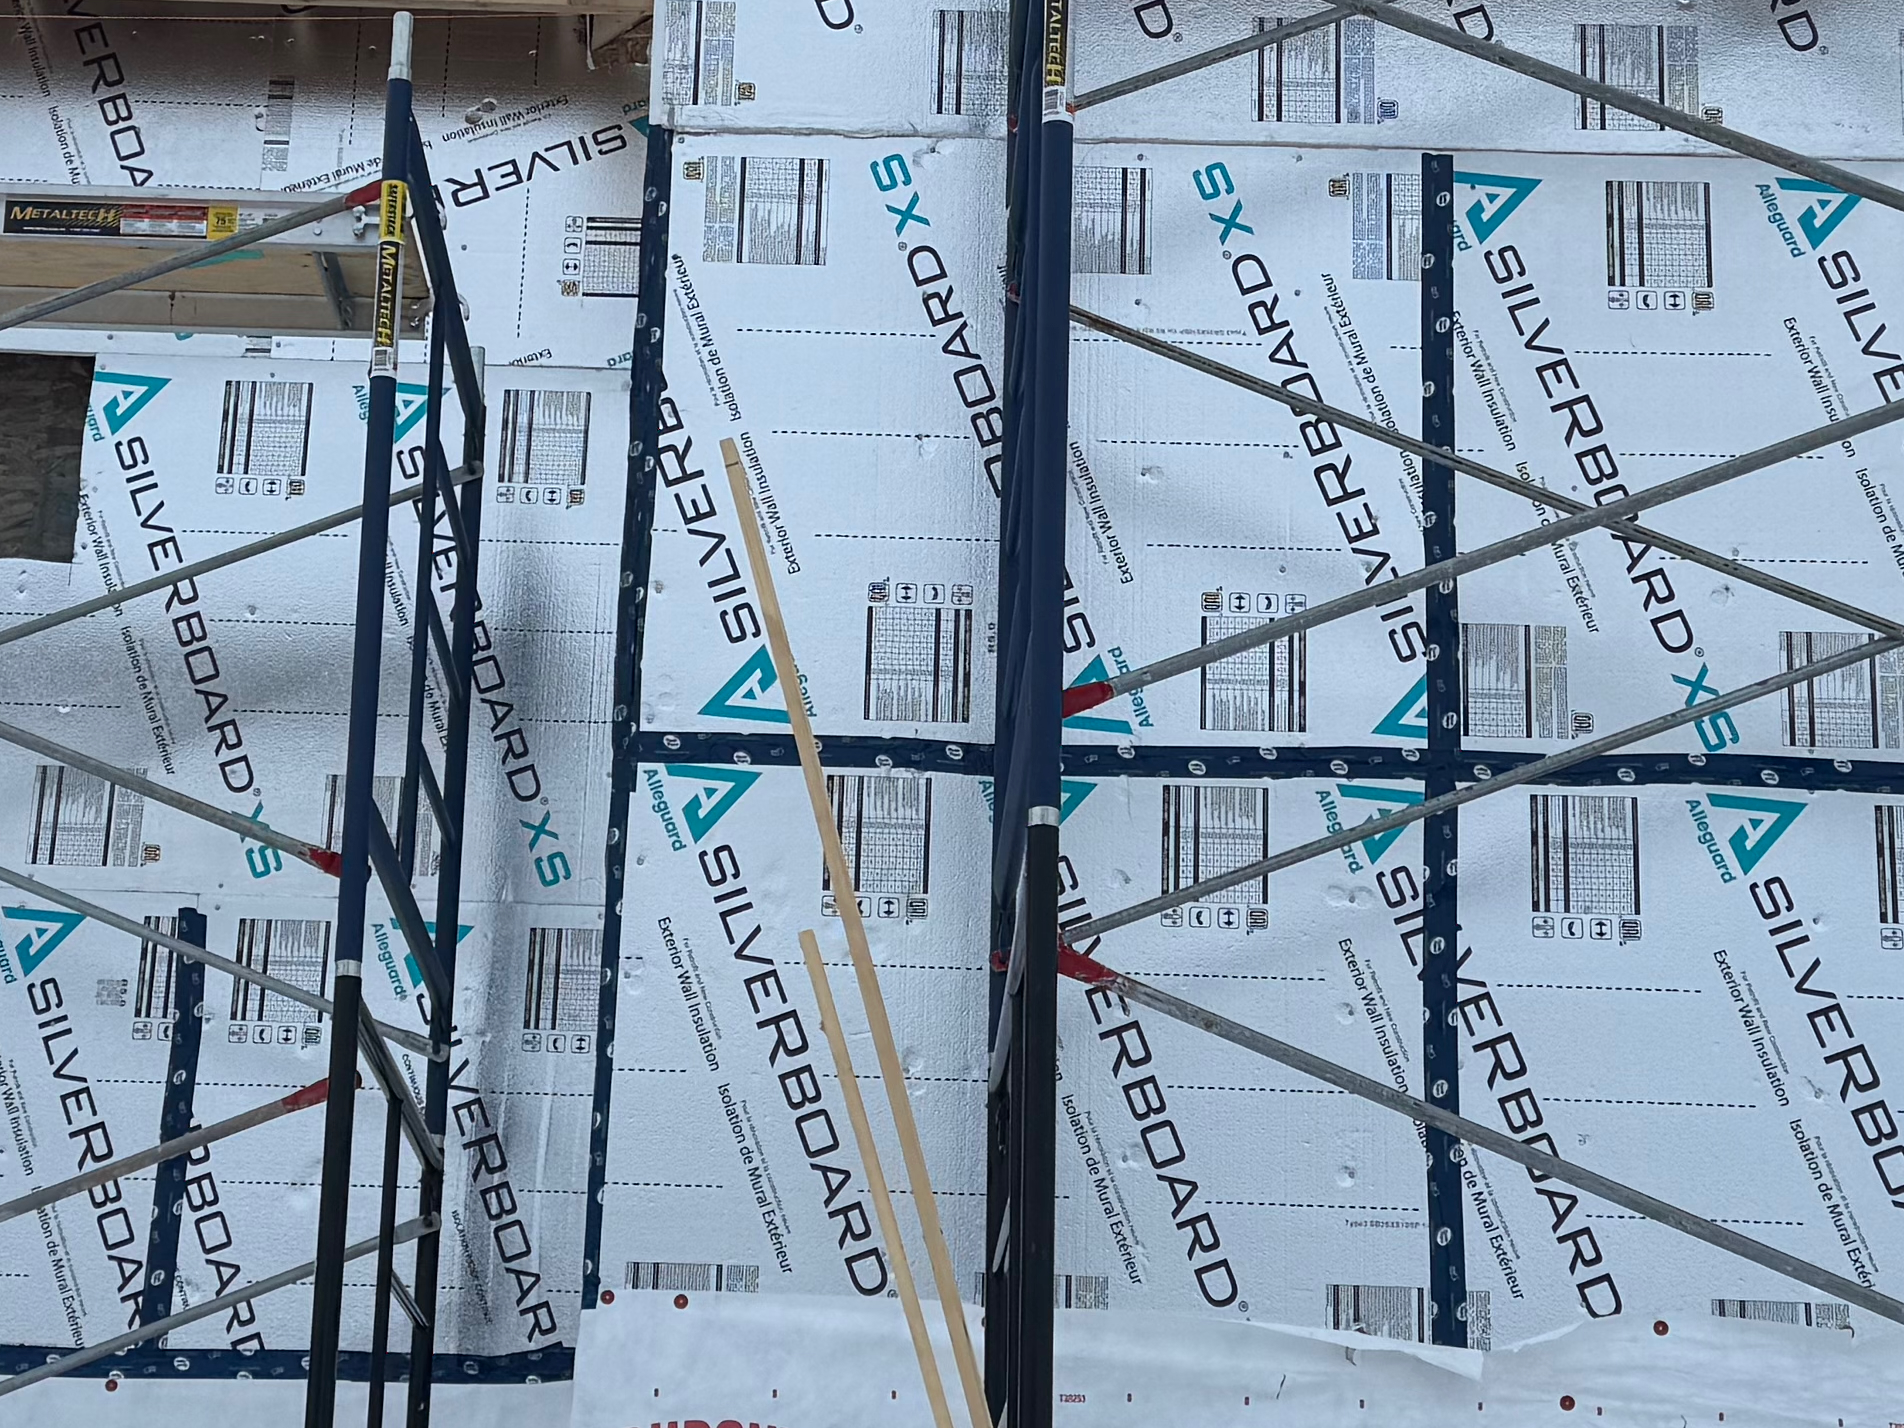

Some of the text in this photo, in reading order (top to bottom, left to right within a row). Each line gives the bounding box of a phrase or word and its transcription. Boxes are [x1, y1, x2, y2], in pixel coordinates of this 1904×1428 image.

[10, 206, 116, 223] METALTECH
[868, 153, 932, 238] XS
[1192, 161, 1255, 246] XS
[1755, 183, 1807, 259] Alleguard
[377, 245, 396, 346] METALTECH
[1068, 441, 1134, 584] Exterior Wall Insulation
[1670, 661, 1741, 753] XS
[519, 809, 572, 888] XS
[642, 768, 687, 853] Alleguard
[1687, 798, 1737, 884] Alleguard
[371, 923, 405, 999] Alleguard
[658, 916, 684, 973] Exterior
[677, 970, 698, 1002] Wall
[689, 996, 721, 1072] Insulation
[1713, 949, 1791, 1108] Exterior Wall Insulation
[717, 1082, 793, 1274] Isolation de Mural Extérieur
[1789, 1118, 1854, 1248] Isolation de Mural
